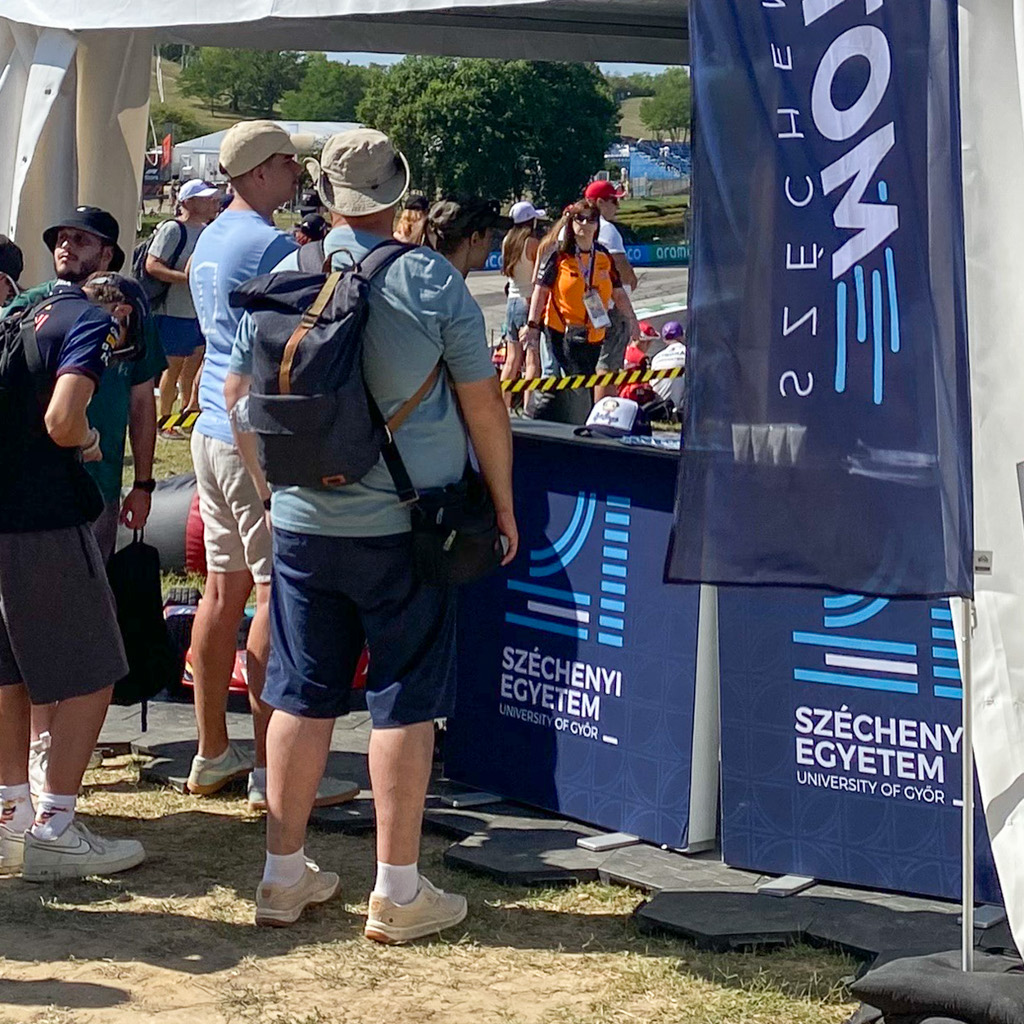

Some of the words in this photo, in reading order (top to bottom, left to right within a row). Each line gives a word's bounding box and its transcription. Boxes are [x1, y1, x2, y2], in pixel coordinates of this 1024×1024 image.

[502, 646, 622, 697] SZÉCHENYI
[499, 702, 554, 727] UNIVERSITY
[554, 717, 569, 731] OF
[501, 673, 601, 721] EGYETEM
[795, 704, 963, 753] SZÉCHENY
[795, 737, 944, 784] EGYETEM
[797, 770, 877, 795] UNIVERSITY
[881, 783, 901, 797] OF
